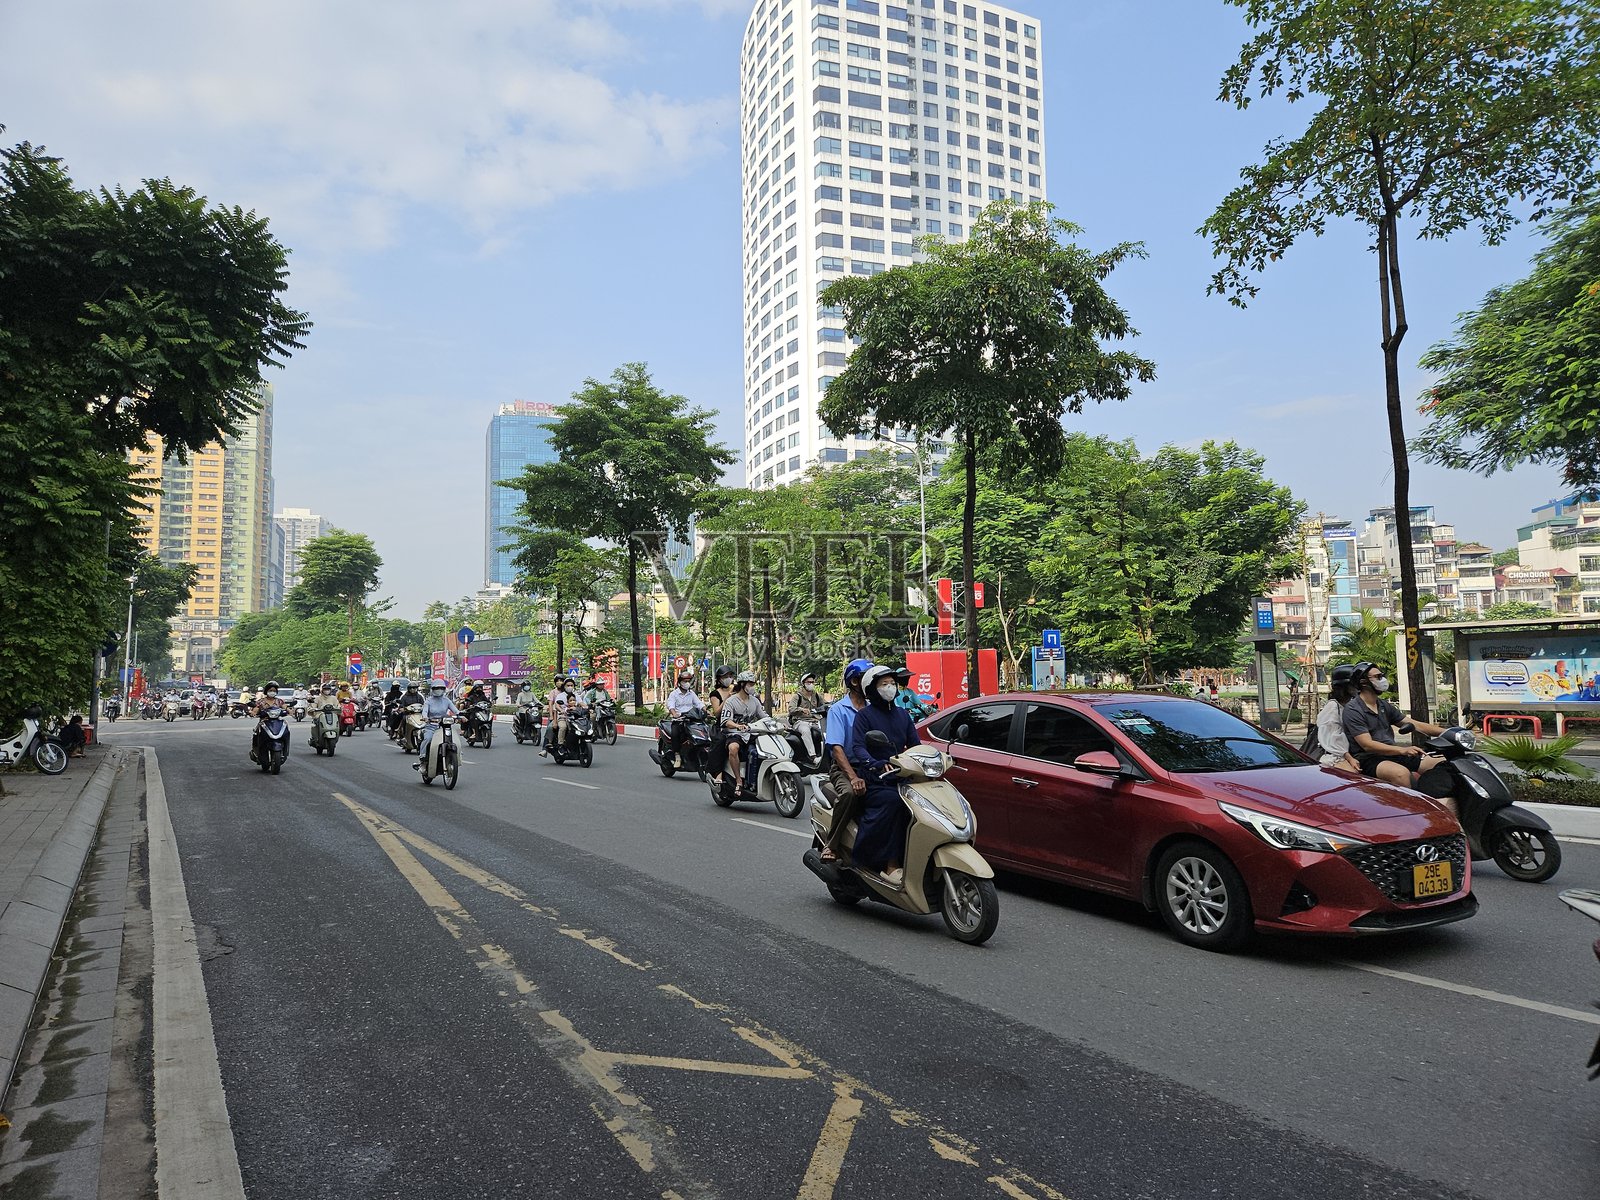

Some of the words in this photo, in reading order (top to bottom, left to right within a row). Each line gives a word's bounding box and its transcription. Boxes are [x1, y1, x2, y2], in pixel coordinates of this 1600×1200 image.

[917, 678, 932, 693] 5G
[1424, 864, 1440, 879] 29E
[1418, 878, 1448, 895] 043.39
